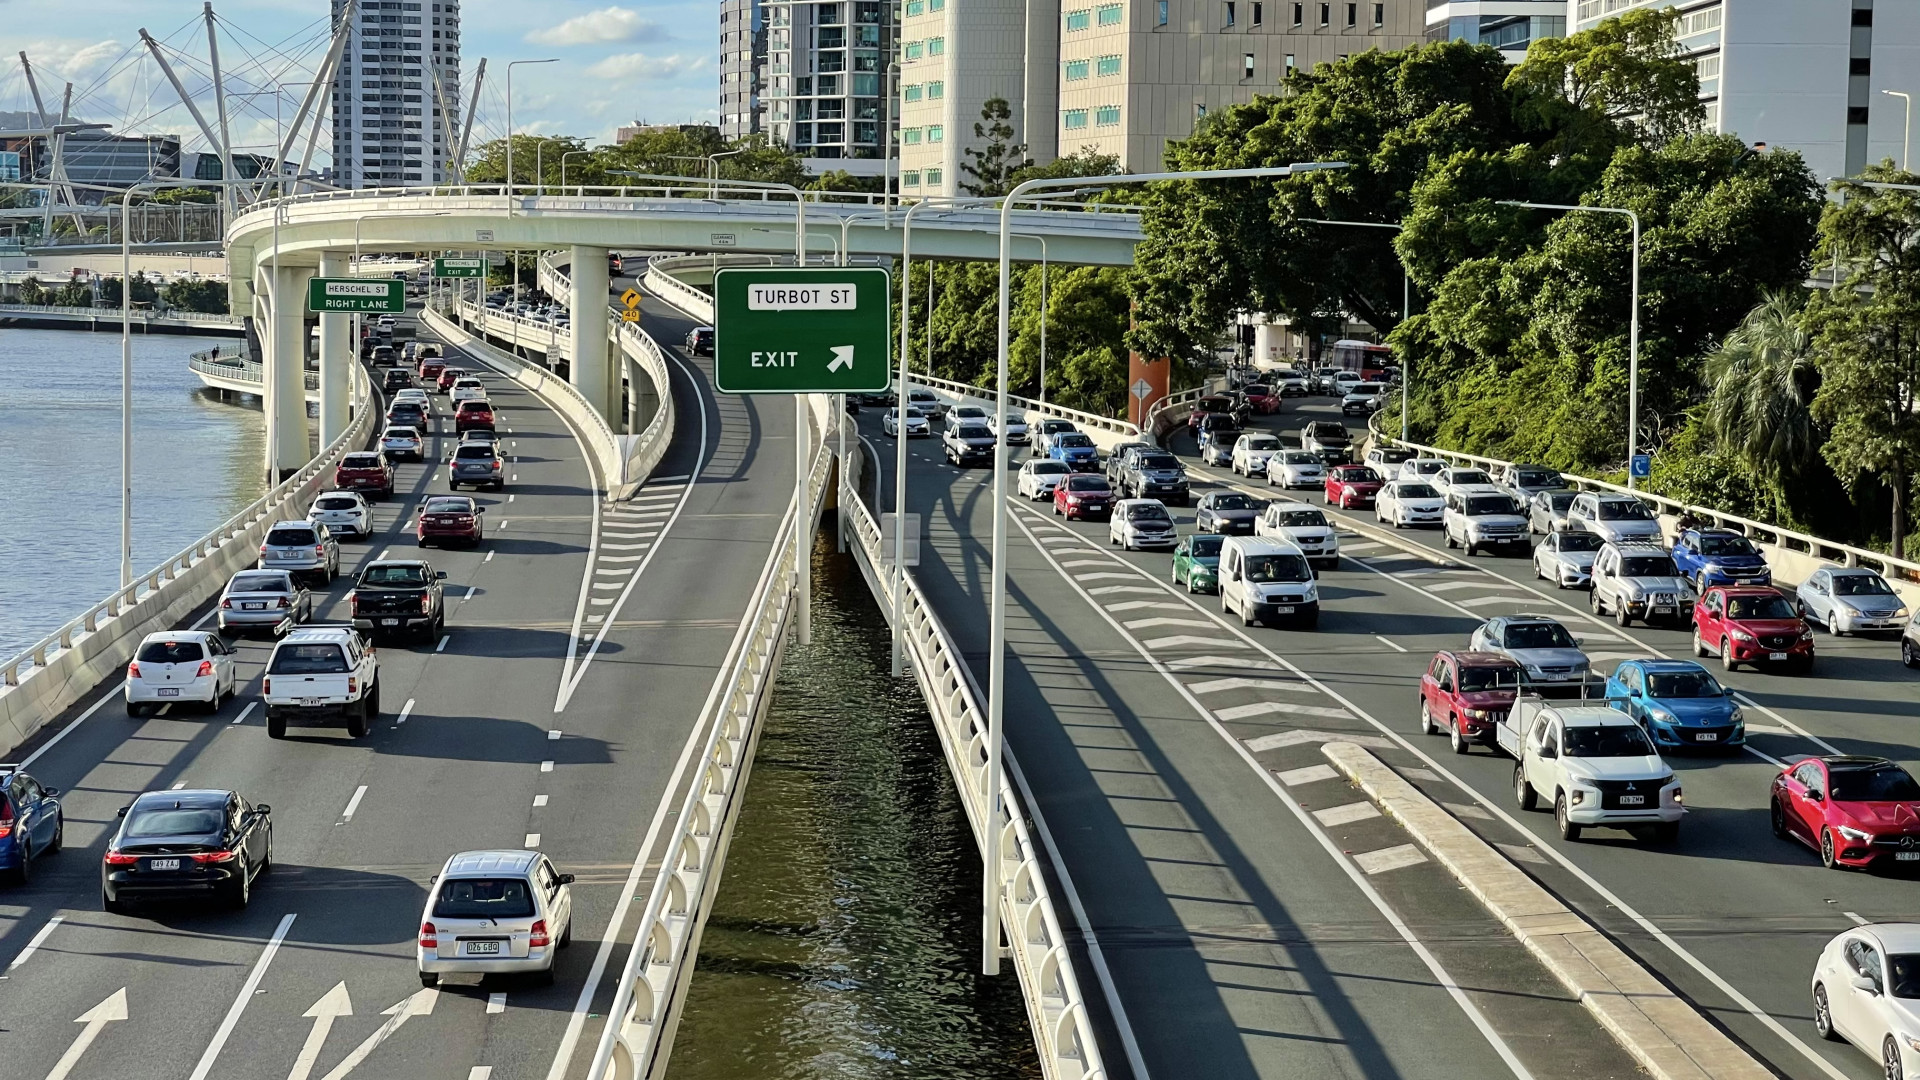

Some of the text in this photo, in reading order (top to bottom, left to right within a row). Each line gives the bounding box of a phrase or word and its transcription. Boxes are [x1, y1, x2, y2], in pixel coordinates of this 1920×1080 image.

[328, 284, 388, 294] HERSCHEL ST
[755, 289, 850, 304] TURBOT ST
[326, 299, 389, 310] RIGHT LANE
[751, 352, 798, 368] EXIT
